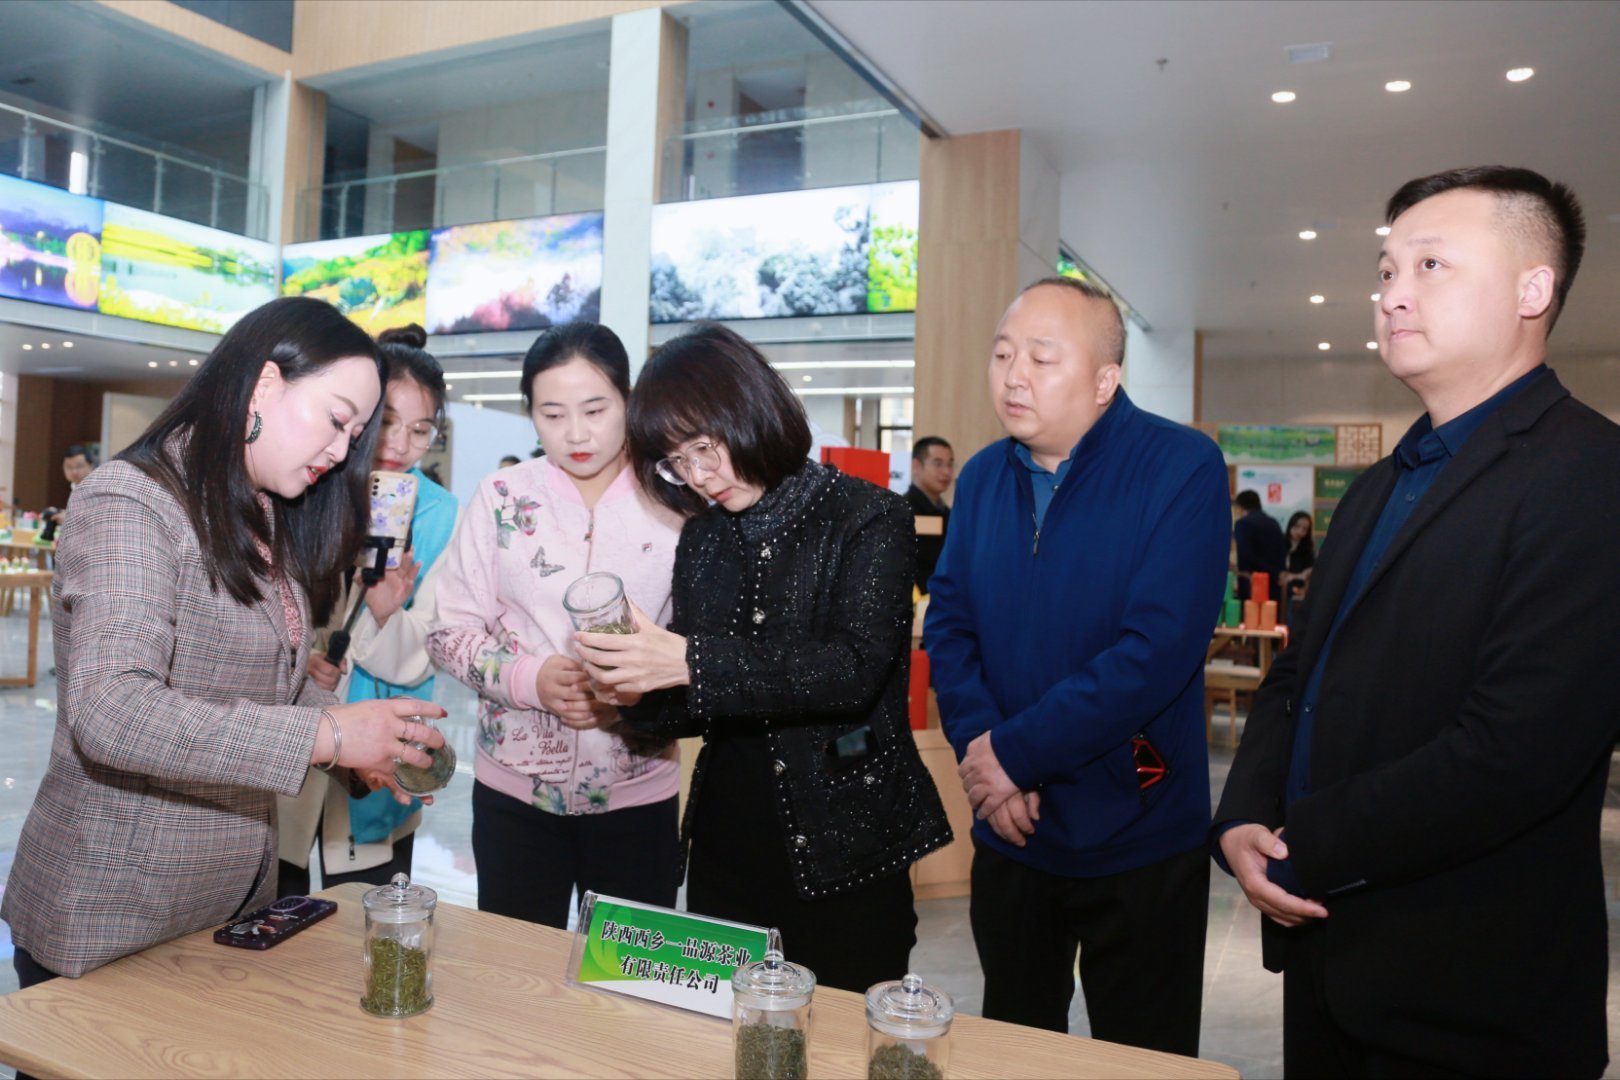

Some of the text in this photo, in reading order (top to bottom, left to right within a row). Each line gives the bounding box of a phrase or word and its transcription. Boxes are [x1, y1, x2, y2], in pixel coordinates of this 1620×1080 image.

[601, 920, 751, 967] 陕西西乡一品源茶业
[620, 955, 720, 994] 有限责任公司
